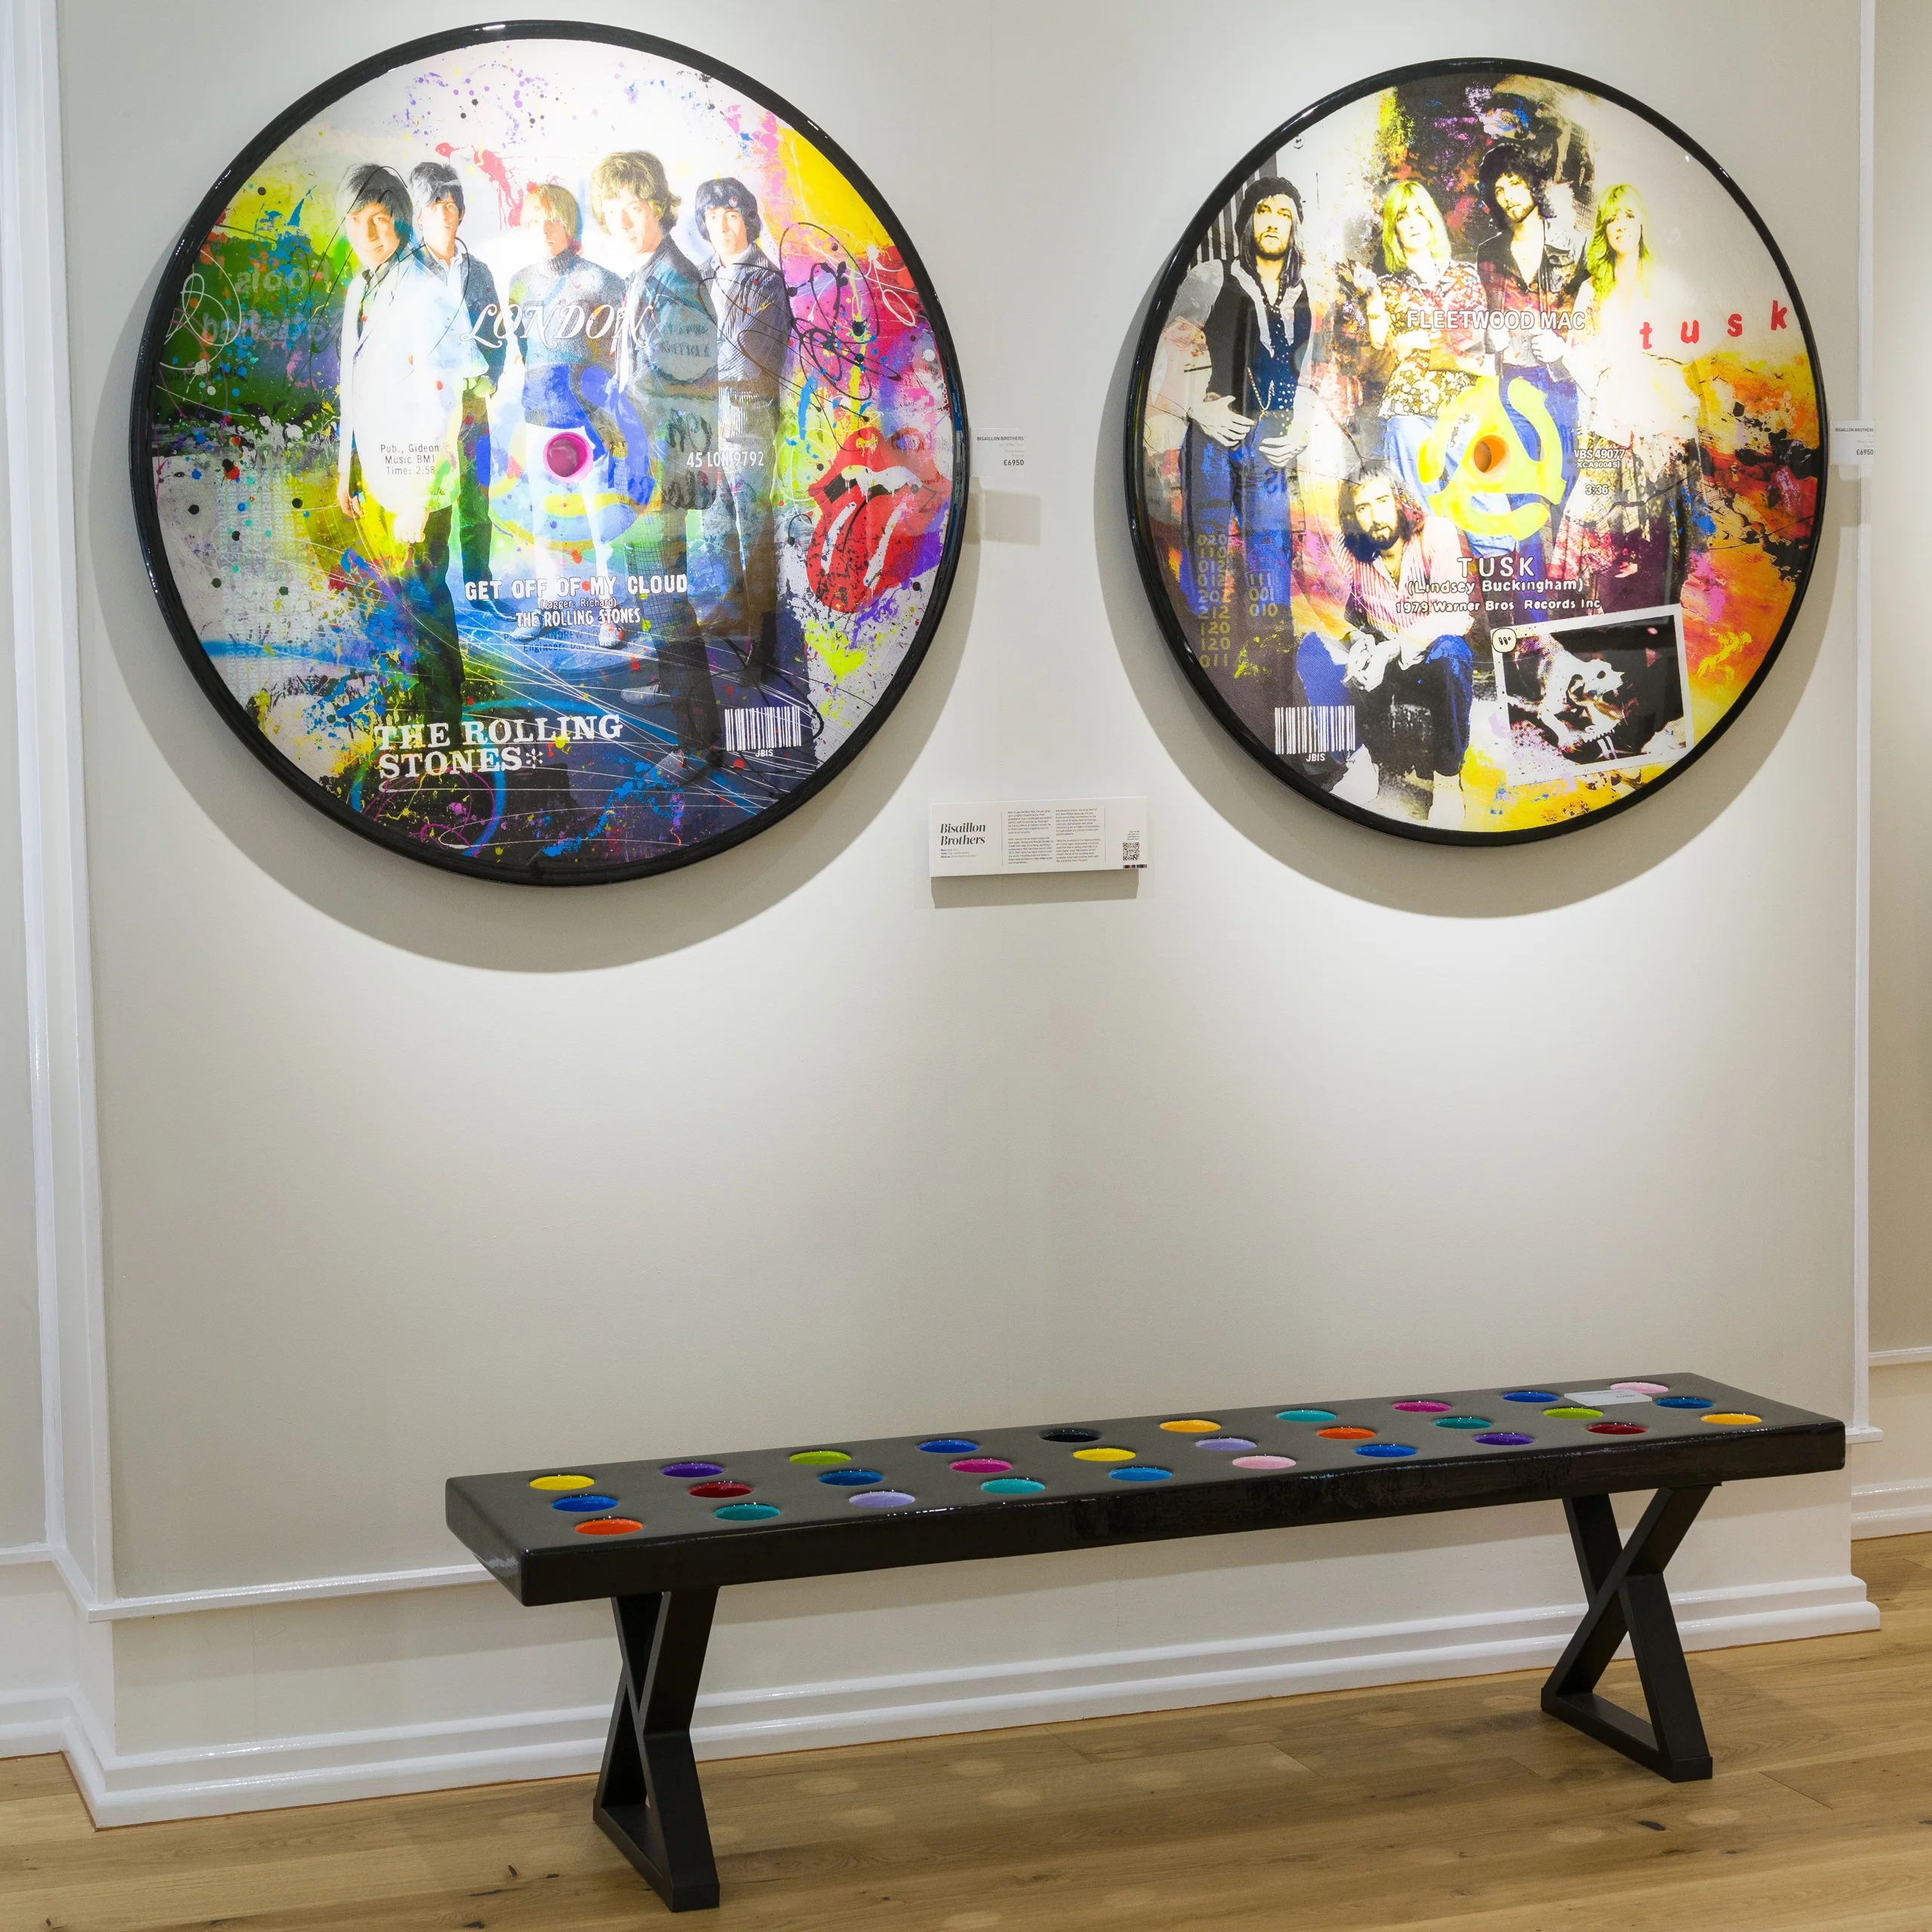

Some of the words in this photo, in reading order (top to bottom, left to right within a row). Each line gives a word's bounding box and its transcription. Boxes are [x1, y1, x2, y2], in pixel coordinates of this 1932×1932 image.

[460, 304, 654, 349] LONDON
[1406, 310, 1535, 330] FLEETWOOD
[1540, 311, 1586, 330] MAC
[408, 444, 439, 453] Gideon
[1594, 448, 1625, 459] 49077
[385, 454, 412, 464] Music
[417, 454, 435, 463] BMI
[687, 451, 703, 468] 45
[733, 451, 764, 466] 9792
[386, 466, 411, 475] Time:
[416, 465, 435, 475] 2:58
[1585, 484, 1609, 495] 3:36
[1457, 556, 1535, 578] TUSK
[465, 580, 502, 601] GET
[512, 578, 548, 598] OFF
[557, 577, 581, 597] OF
[590, 576, 617, 595] MY
[627, 574, 688, 594] CLOUD
[1482, 578, 1583, 593] Buckingham)
[580, 598, 617, 608] Richard)
[1395, 601, 1429, 614] 1979
[1433, 601, 1481, 612] Warner
[1484, 601, 1515, 611] Bros
[1524, 598, 1576, 610] Records
[1580, 598, 1601, 609] Inc
[515, 611, 539, 628] THE
[544, 610, 594, 627] ROLLING
[598, 608, 641, 624] STONES
[1200, 621, 1231, 635] 120
[1201, 637, 1231, 651] 120
[1199, 654, 1228, 668] 011
[374, 722, 451, 750] THE
[462, 714, 623, 746] ROLLING
[755, 749, 774, 757] JBIS
[1306, 753, 1325, 762] JBIS
[379, 746, 522, 780] STONES
[940, 822, 986, 833] Bisaillon
[940, 835, 986, 845] Brothers
